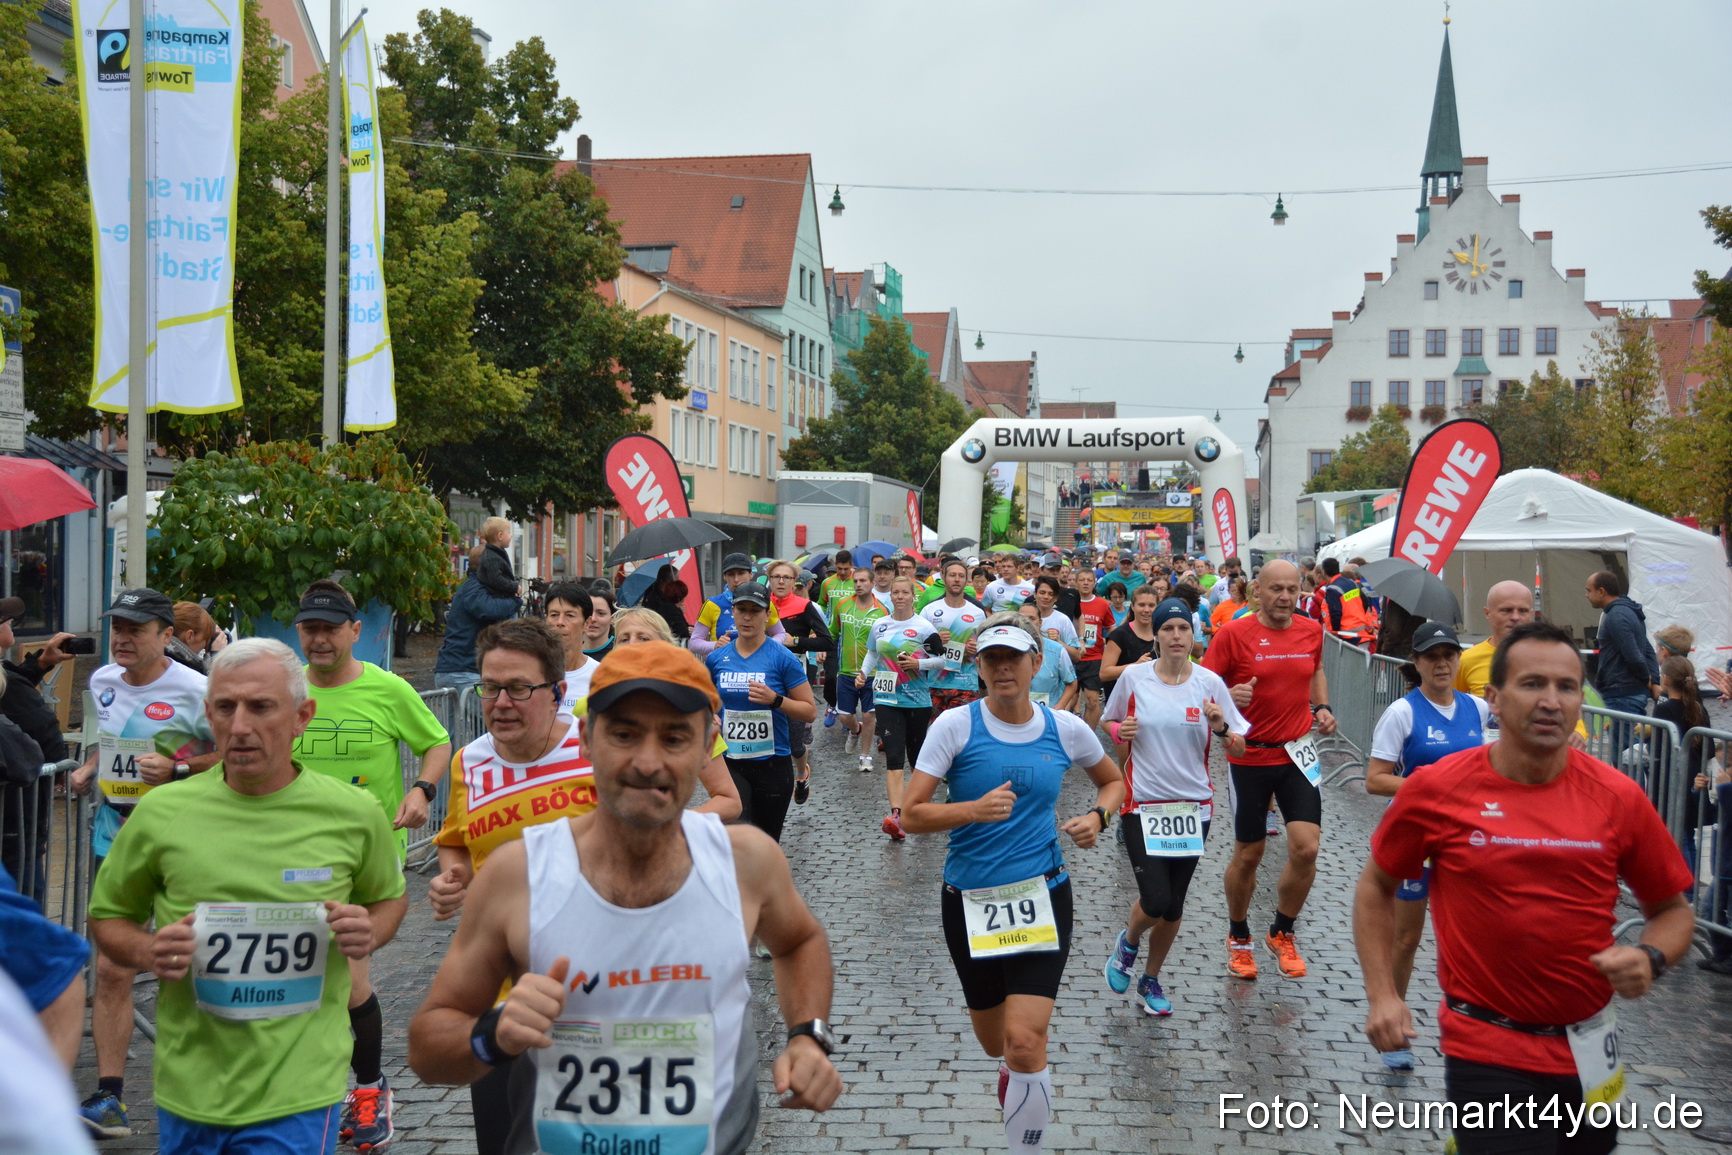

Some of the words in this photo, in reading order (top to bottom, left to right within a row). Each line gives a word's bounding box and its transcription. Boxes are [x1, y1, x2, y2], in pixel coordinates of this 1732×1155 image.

[995, 428, 1060, 448] BMW
[1067, 427, 1186, 450] Laufsport
[1400, 440, 1487, 570] REWE
[1132, 512, 1154, 520] ZIEL
[720, 672, 766, 683] HUBER
[874, 679, 894, 692] 2430
[148, 705, 172, 716] Hervis
[728, 722, 768, 740] 2289
[742, 744, 752, 752] Evi
[112, 784, 140, 794] Lothar
[468, 803, 524, 840] MAX
[1148, 815, 1197, 836] 2800
[1160, 841, 1188, 849] Marina
[1490, 836, 1540, 848] Amberger
[1542, 838, 1602, 849] Kaolinwerke
[999, 882, 1039, 898] BOCK
[205, 916, 248, 924] NeuerMarkt
[256, 907, 318, 922] BOCK
[984, 899, 1036, 932] 219
[999, 933, 1028, 945] Hilde
[206, 931, 318, 974] 2759
[608, 964, 712, 988] KLEBL
[231, 986, 286, 1004] Alfons
[552, 1032, 603, 1045] NeuerMarkt
[613, 1022, 698, 1041] BOCK
[554, 1054, 697, 1116] 2315
[582, 1131, 661, 1155] Roland
